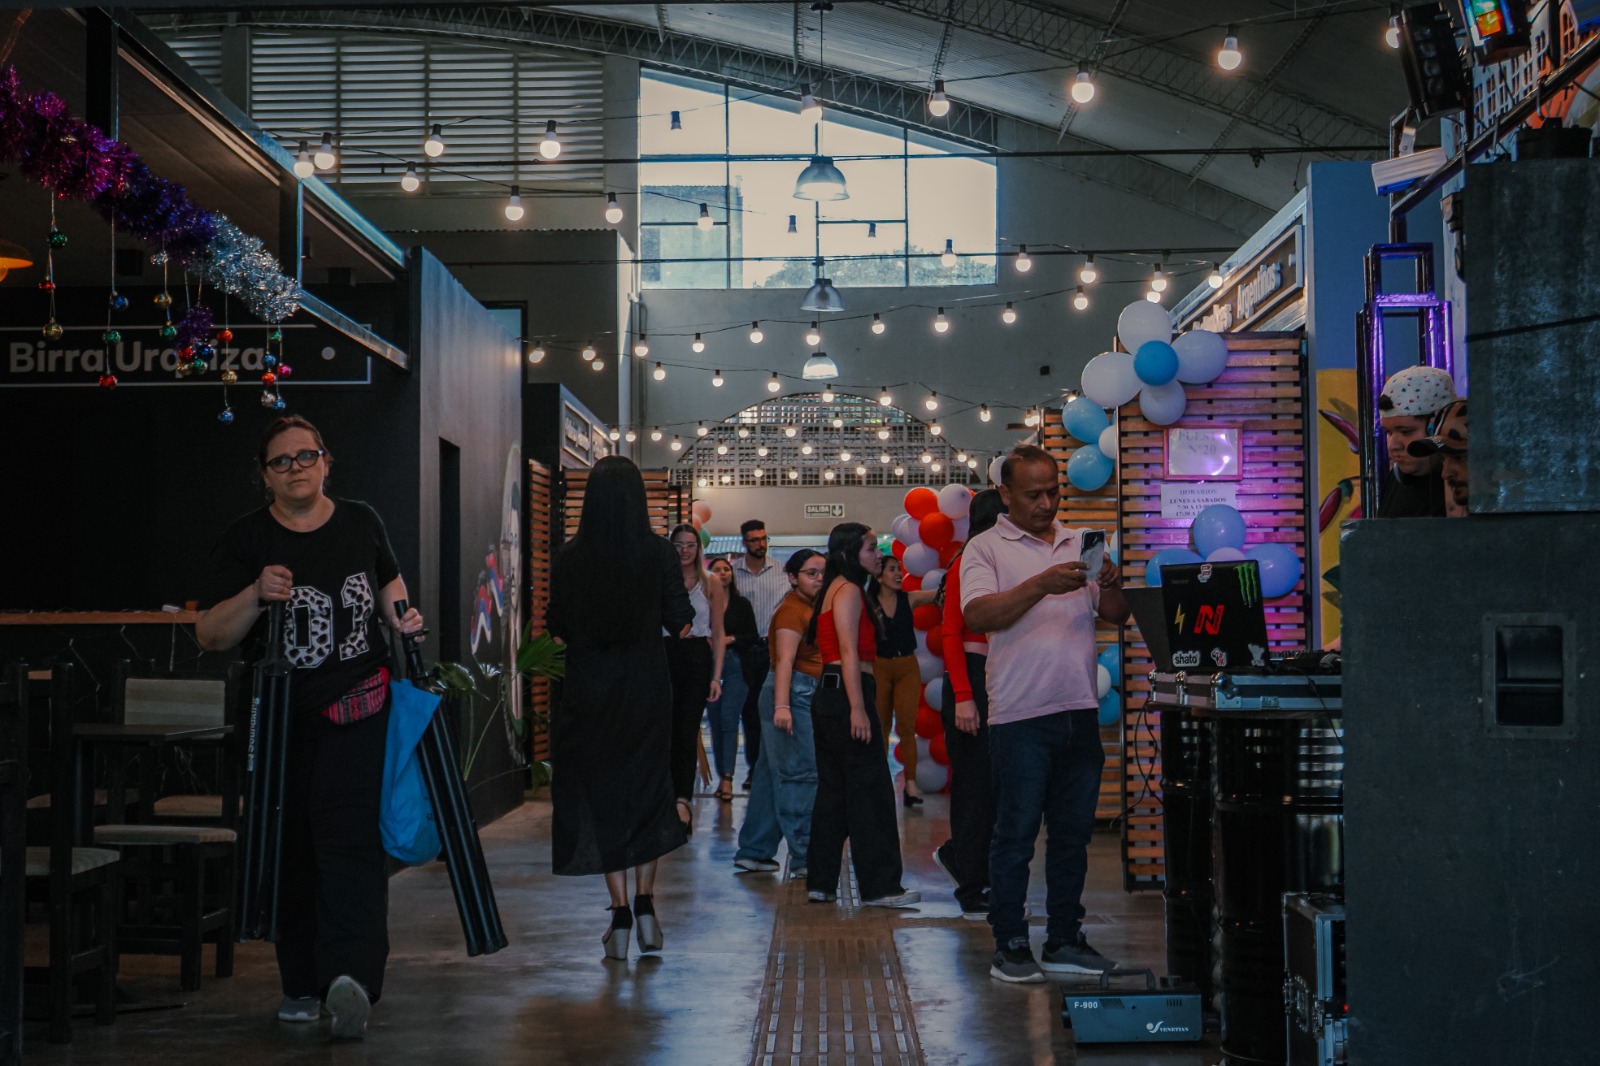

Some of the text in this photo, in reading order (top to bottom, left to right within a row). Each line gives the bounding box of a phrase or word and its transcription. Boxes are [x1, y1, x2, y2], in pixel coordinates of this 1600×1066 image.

[8, 339, 265, 378] Birra Urqiza
[1175, 653, 1197, 664] shato
[1074, 1001, 1098, 1009] F-900
